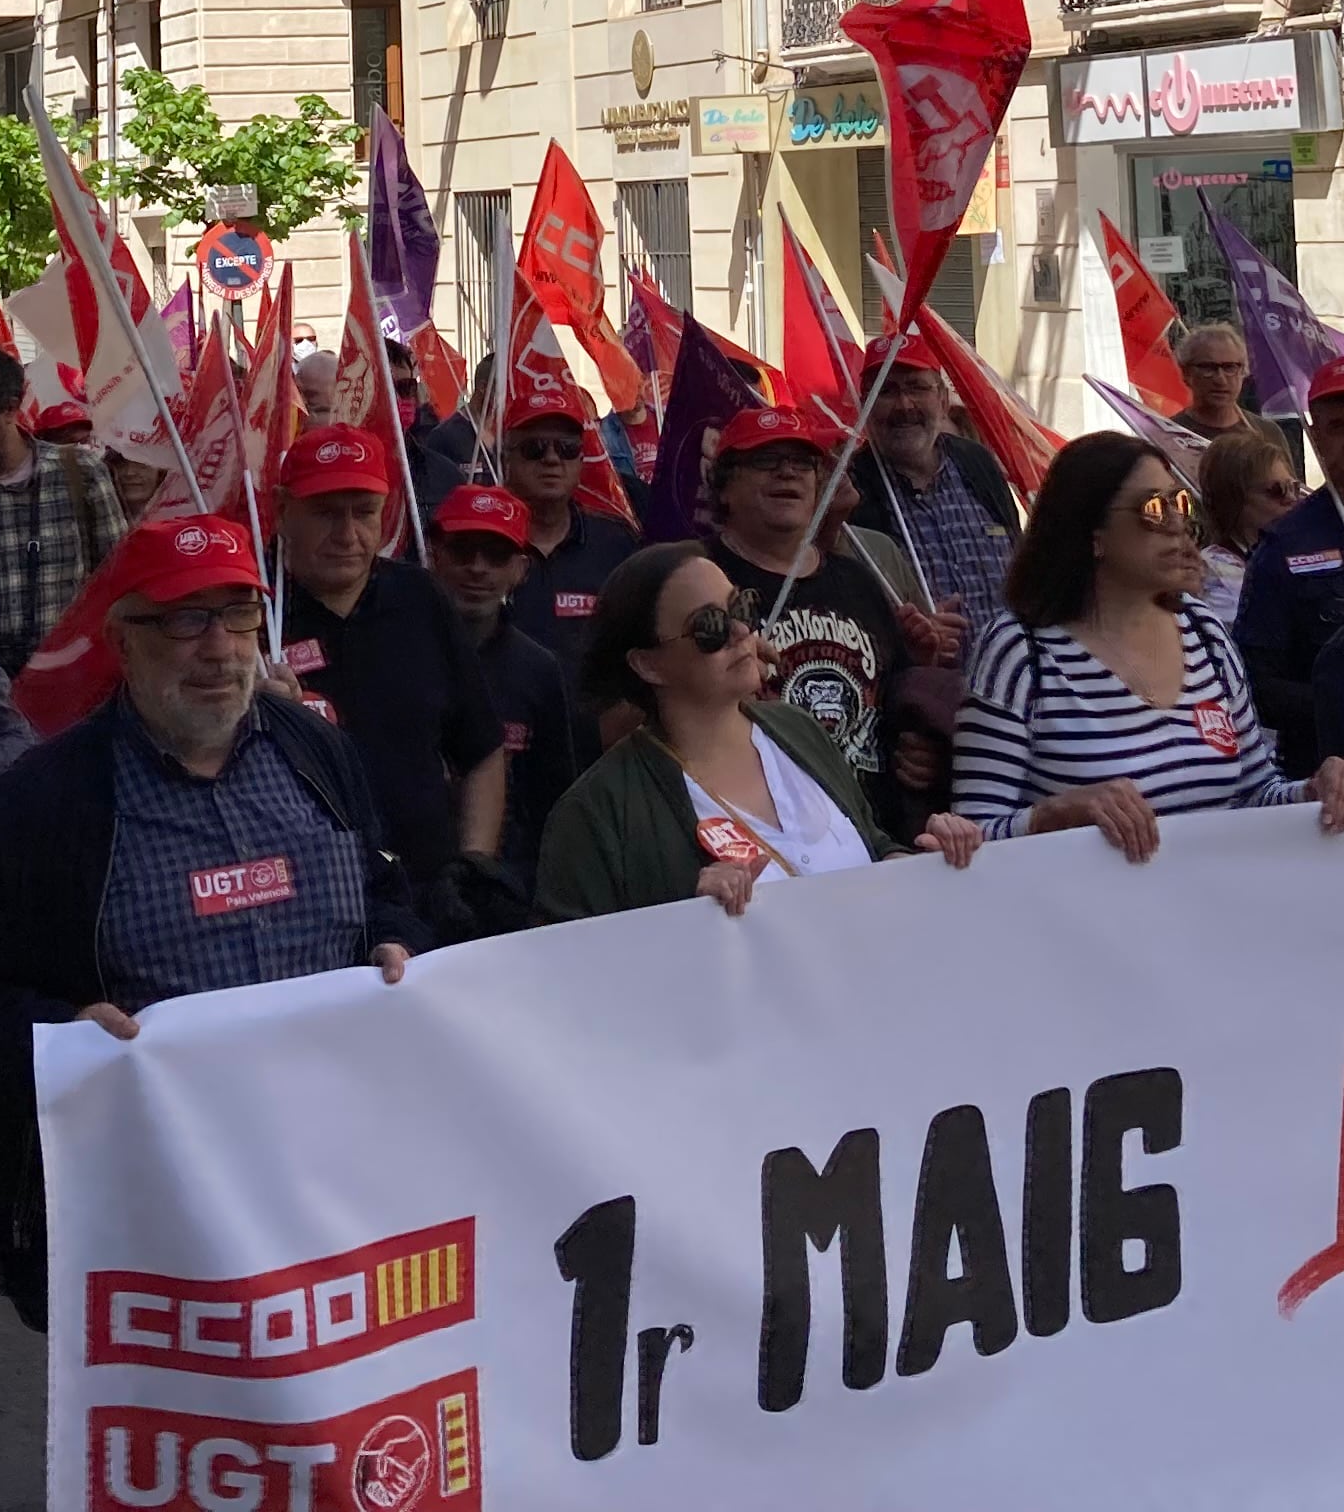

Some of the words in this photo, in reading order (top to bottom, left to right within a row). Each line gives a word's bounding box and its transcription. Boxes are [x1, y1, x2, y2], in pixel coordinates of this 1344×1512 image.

[215, 254, 257, 268] EXCEPTE
[556, 594, 587, 608] UGT
[789, 608, 876, 680] Monkey
[194, 868, 247, 898] UGT
[553, 1193, 695, 1462] 1r
[757, 1066, 1184, 1413] MAIG
[108, 1271, 367, 1359] CCOO
[103, 1424, 337, 1512] UGT
